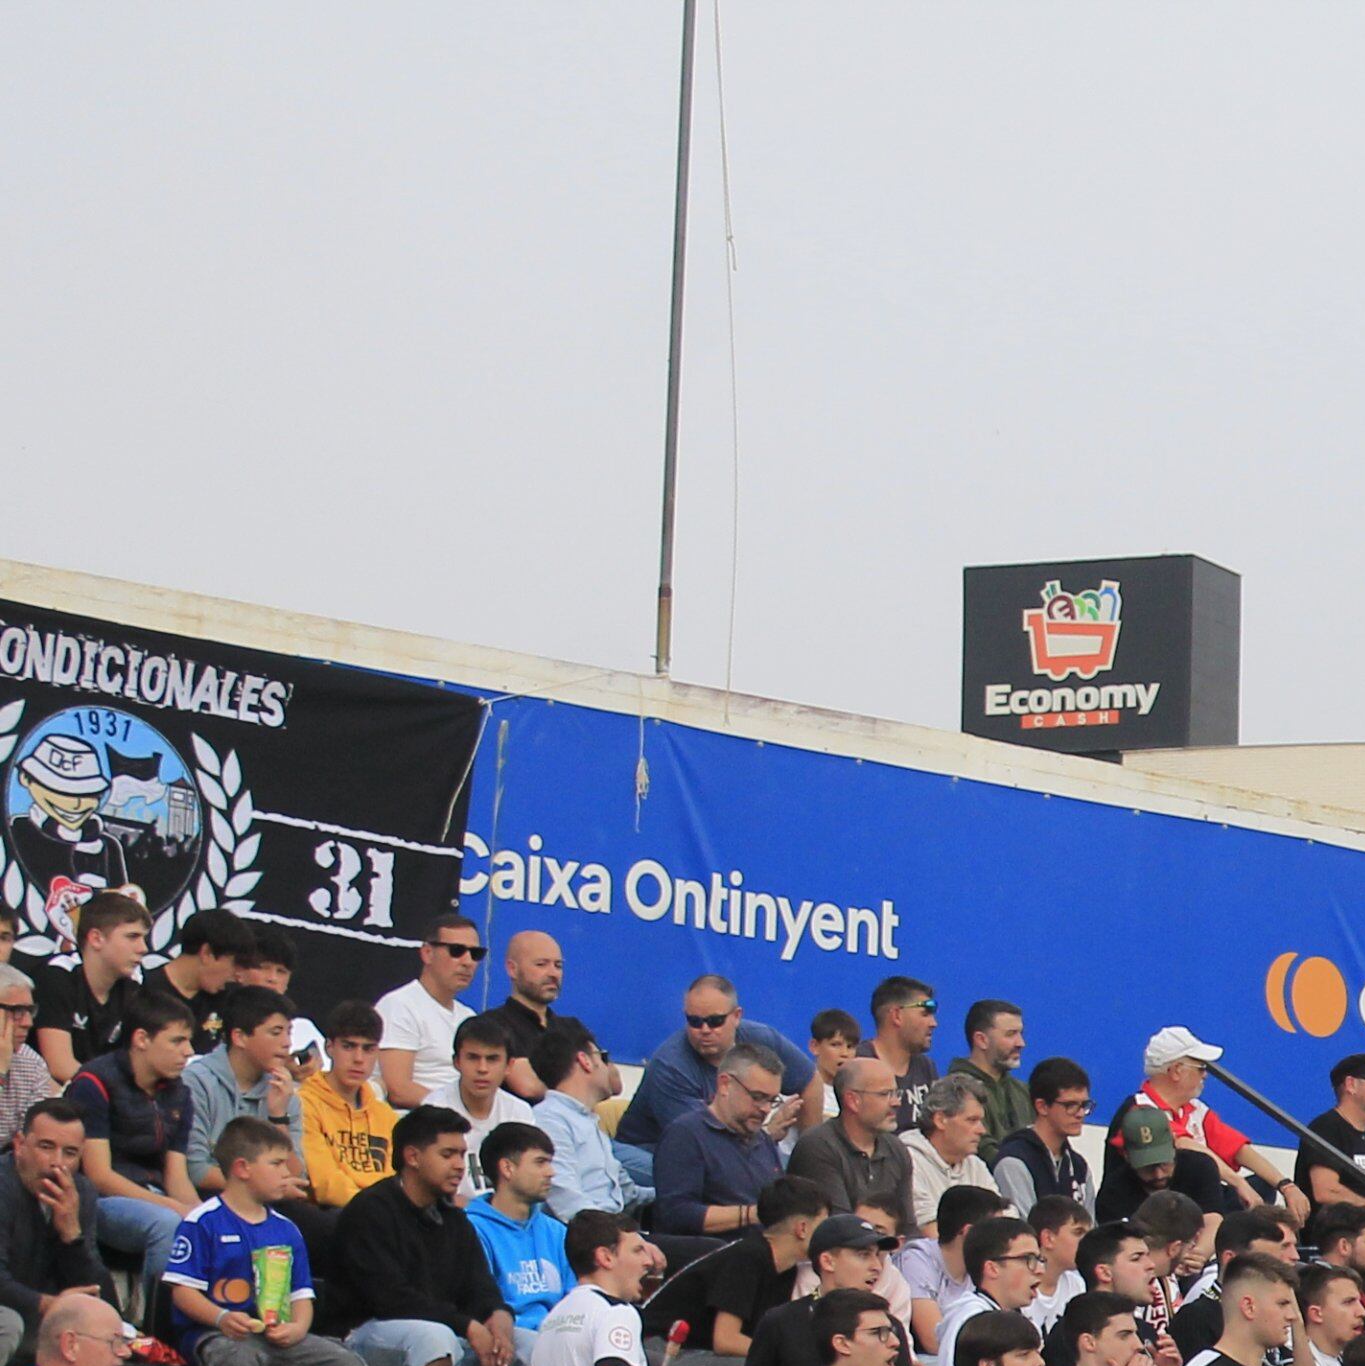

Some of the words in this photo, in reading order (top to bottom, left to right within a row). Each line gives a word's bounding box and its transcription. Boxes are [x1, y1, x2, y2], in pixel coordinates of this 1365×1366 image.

[985, 683, 1160, 716] Economy
[74, 711, 132, 742] 1931
[1033, 712, 1113, 728] CASH
[309, 840, 394, 929] 31
[461, 833, 612, 917] Caixa
[624, 859, 901, 960] Ontinyent
